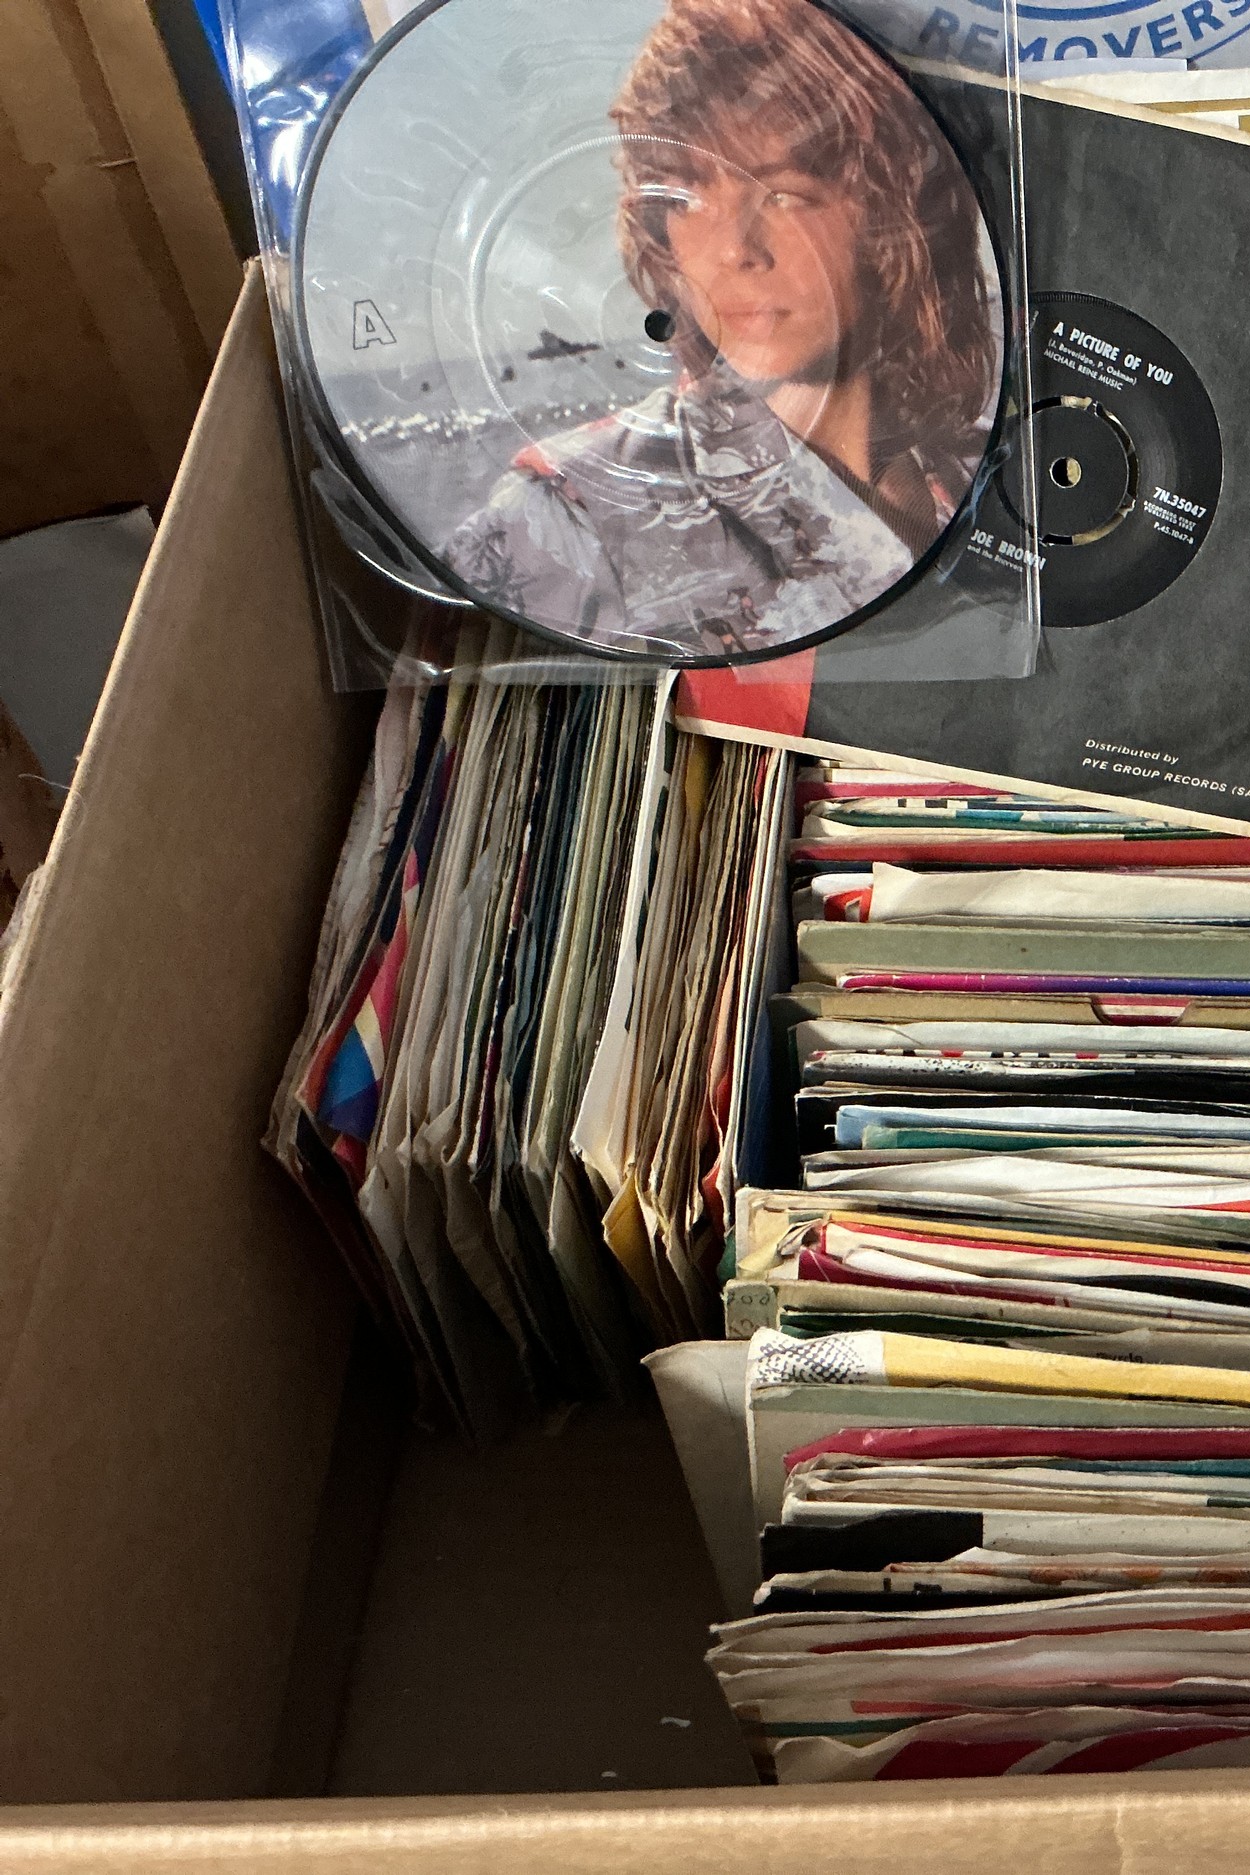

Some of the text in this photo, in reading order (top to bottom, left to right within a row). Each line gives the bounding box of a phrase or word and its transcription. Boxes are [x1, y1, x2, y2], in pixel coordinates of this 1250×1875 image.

[353, 299, 397, 350] A
[1044, 349, 1076, 370] MICHAEL
[1098, 375, 1123, 390] MUSIC
[1053, 321, 1173, 385] A PICTURE OF YOU
[1153, 486, 1206, 518] 7N.35047
[971, 529, 1046, 570] JOE BROWN
[1085, 739, 1179, 765] Distributed by
[1082, 758, 1107, 770] PYE
[1113, 763, 1160, 779] GROUP
[1164, 772, 1226, 792] RECORDS
